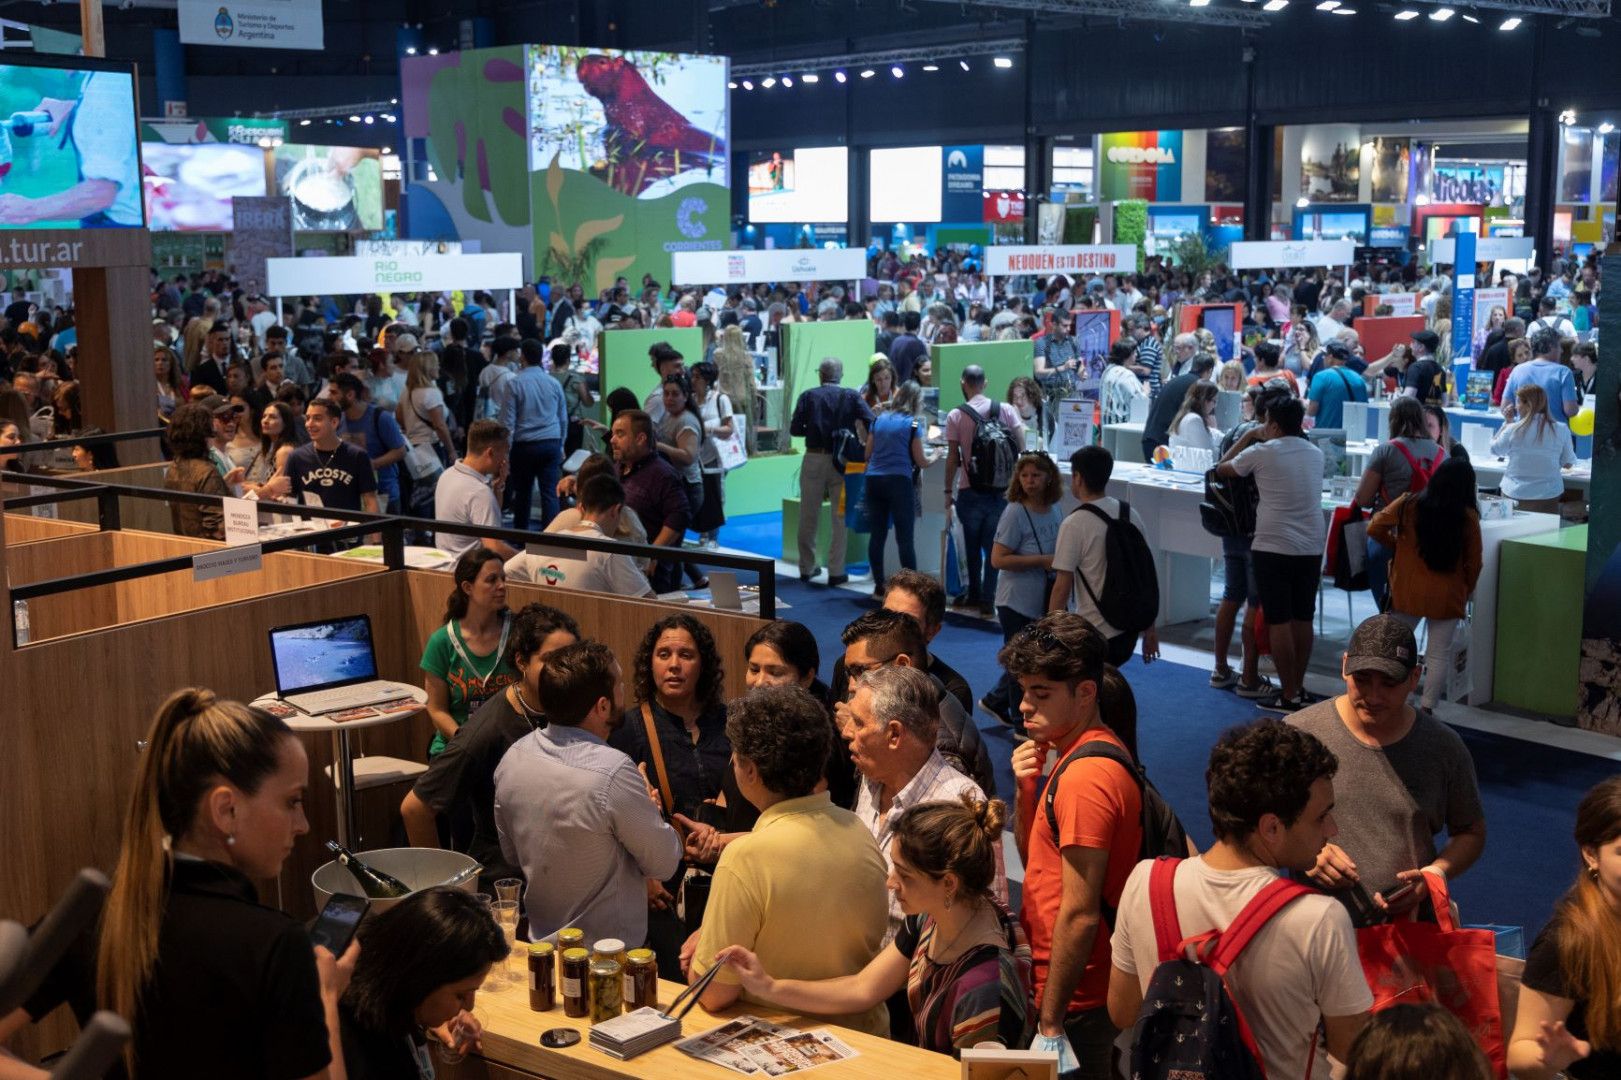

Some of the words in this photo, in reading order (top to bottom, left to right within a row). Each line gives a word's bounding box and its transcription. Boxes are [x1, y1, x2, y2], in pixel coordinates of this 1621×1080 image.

[237, 13, 268, 22] Ministerio
[267, 23, 295, 31] Deportes
[239, 30, 275, 40] Argentina
[0, 238, 83, 263] .tur.ar
[1008, 249, 1054, 271] NEUQUÉN
[1056, 256, 1065, 268] ES
[1066, 255, 1075, 268] TU
[1077, 252, 1116, 269] DESTINO
[301, 467, 354, 486] LACOSTE
[230, 512, 251, 520] MENDOZA
